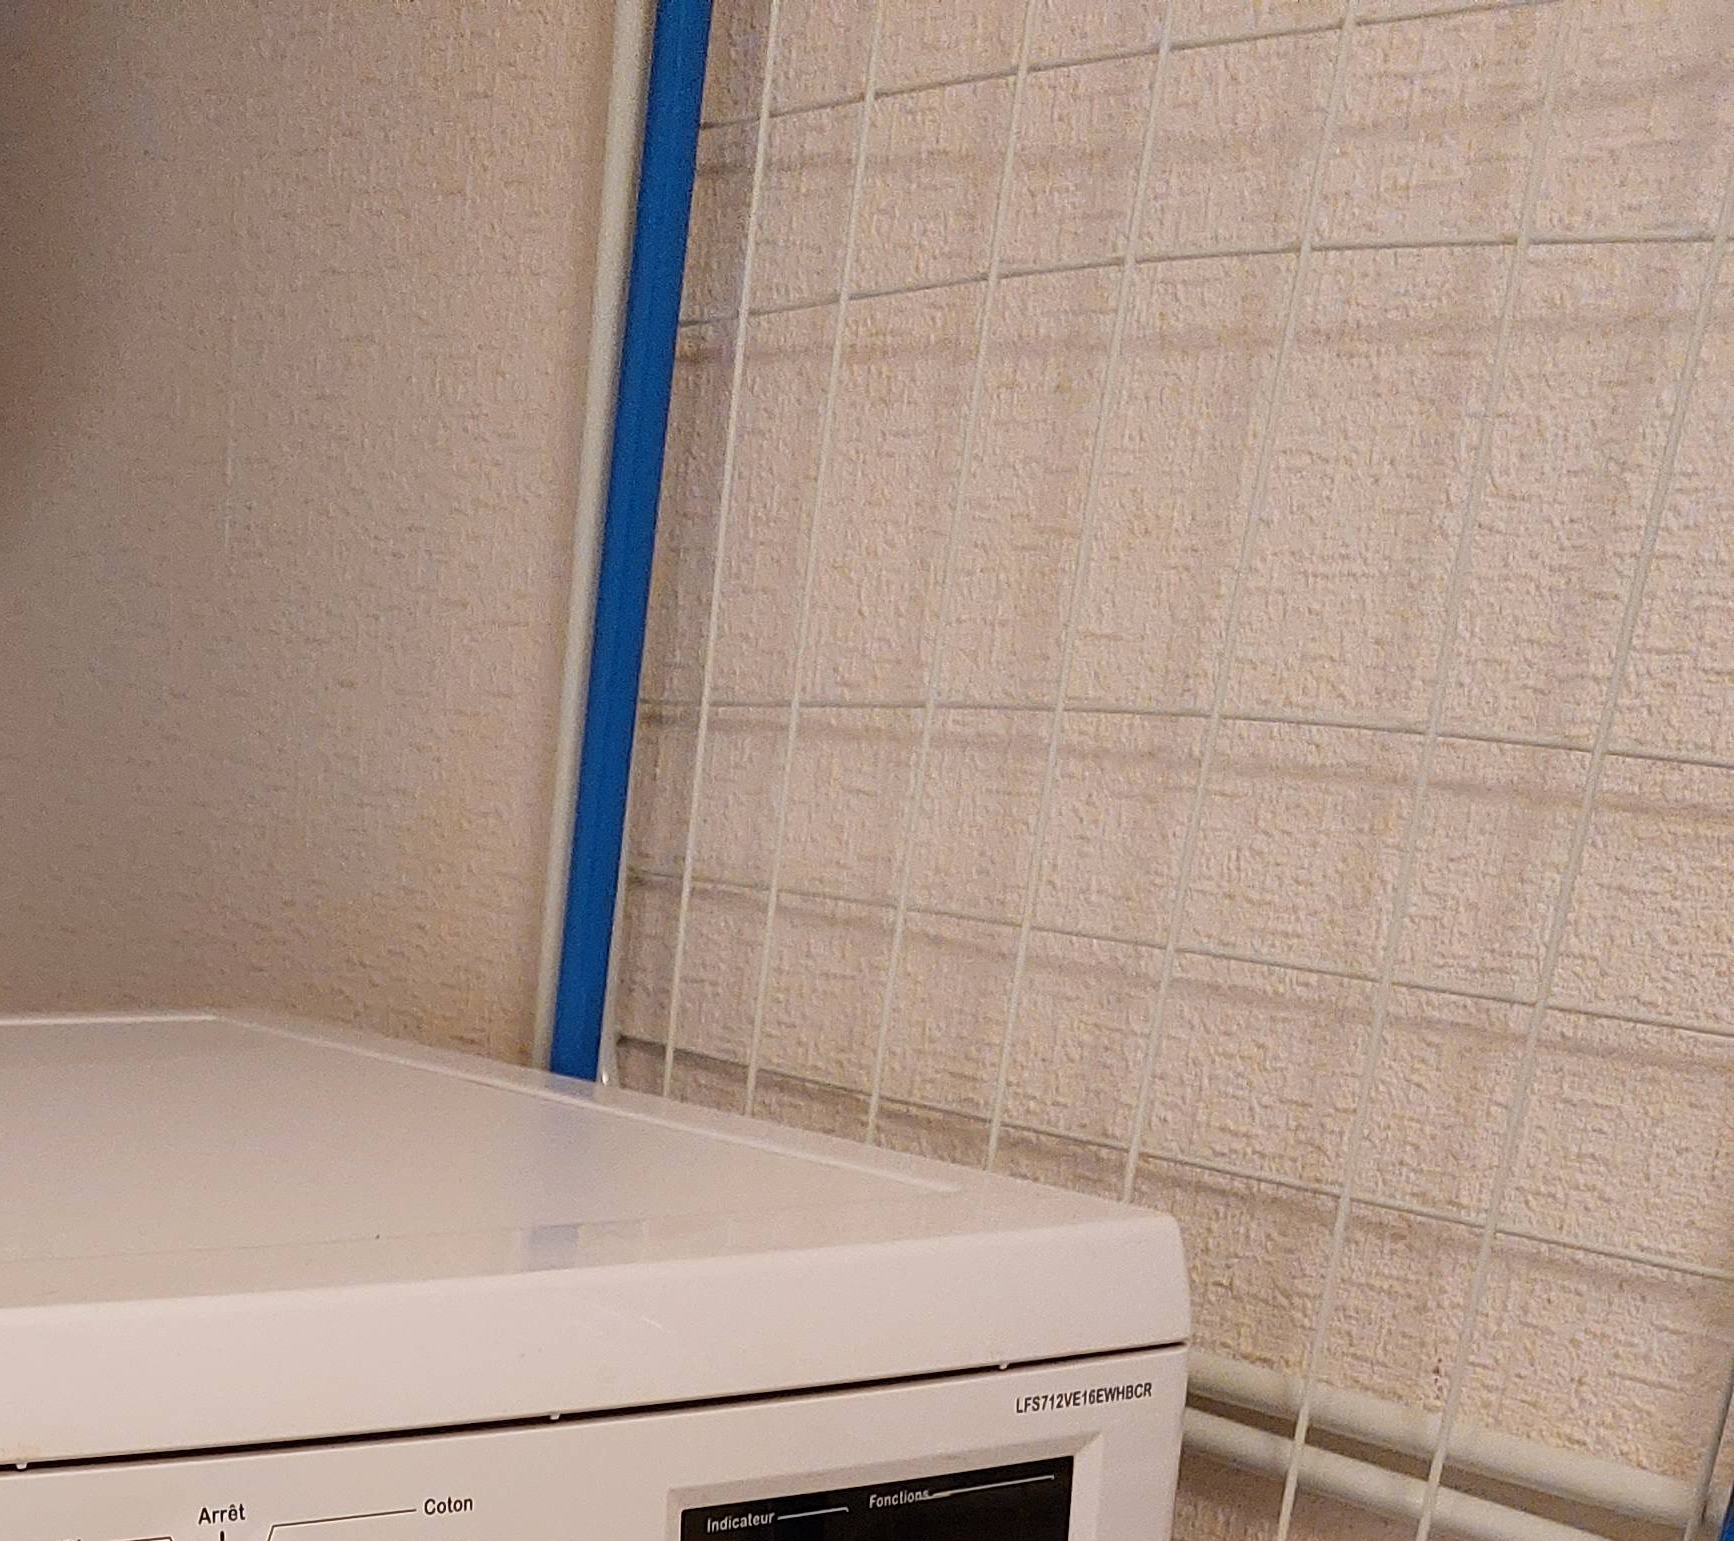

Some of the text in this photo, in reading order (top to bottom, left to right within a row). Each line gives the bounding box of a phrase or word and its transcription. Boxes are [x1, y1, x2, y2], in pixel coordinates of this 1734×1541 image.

[1015, 1382, 1152, 1414] LFS712VE16EWHBCR
[423, 1496, 473, 1516] Coton
[868, 1489, 930, 1509] Fonctions
[197, 1503, 246, 1525] Arrêt
[706, 1512, 775, 1533] Indicateur
